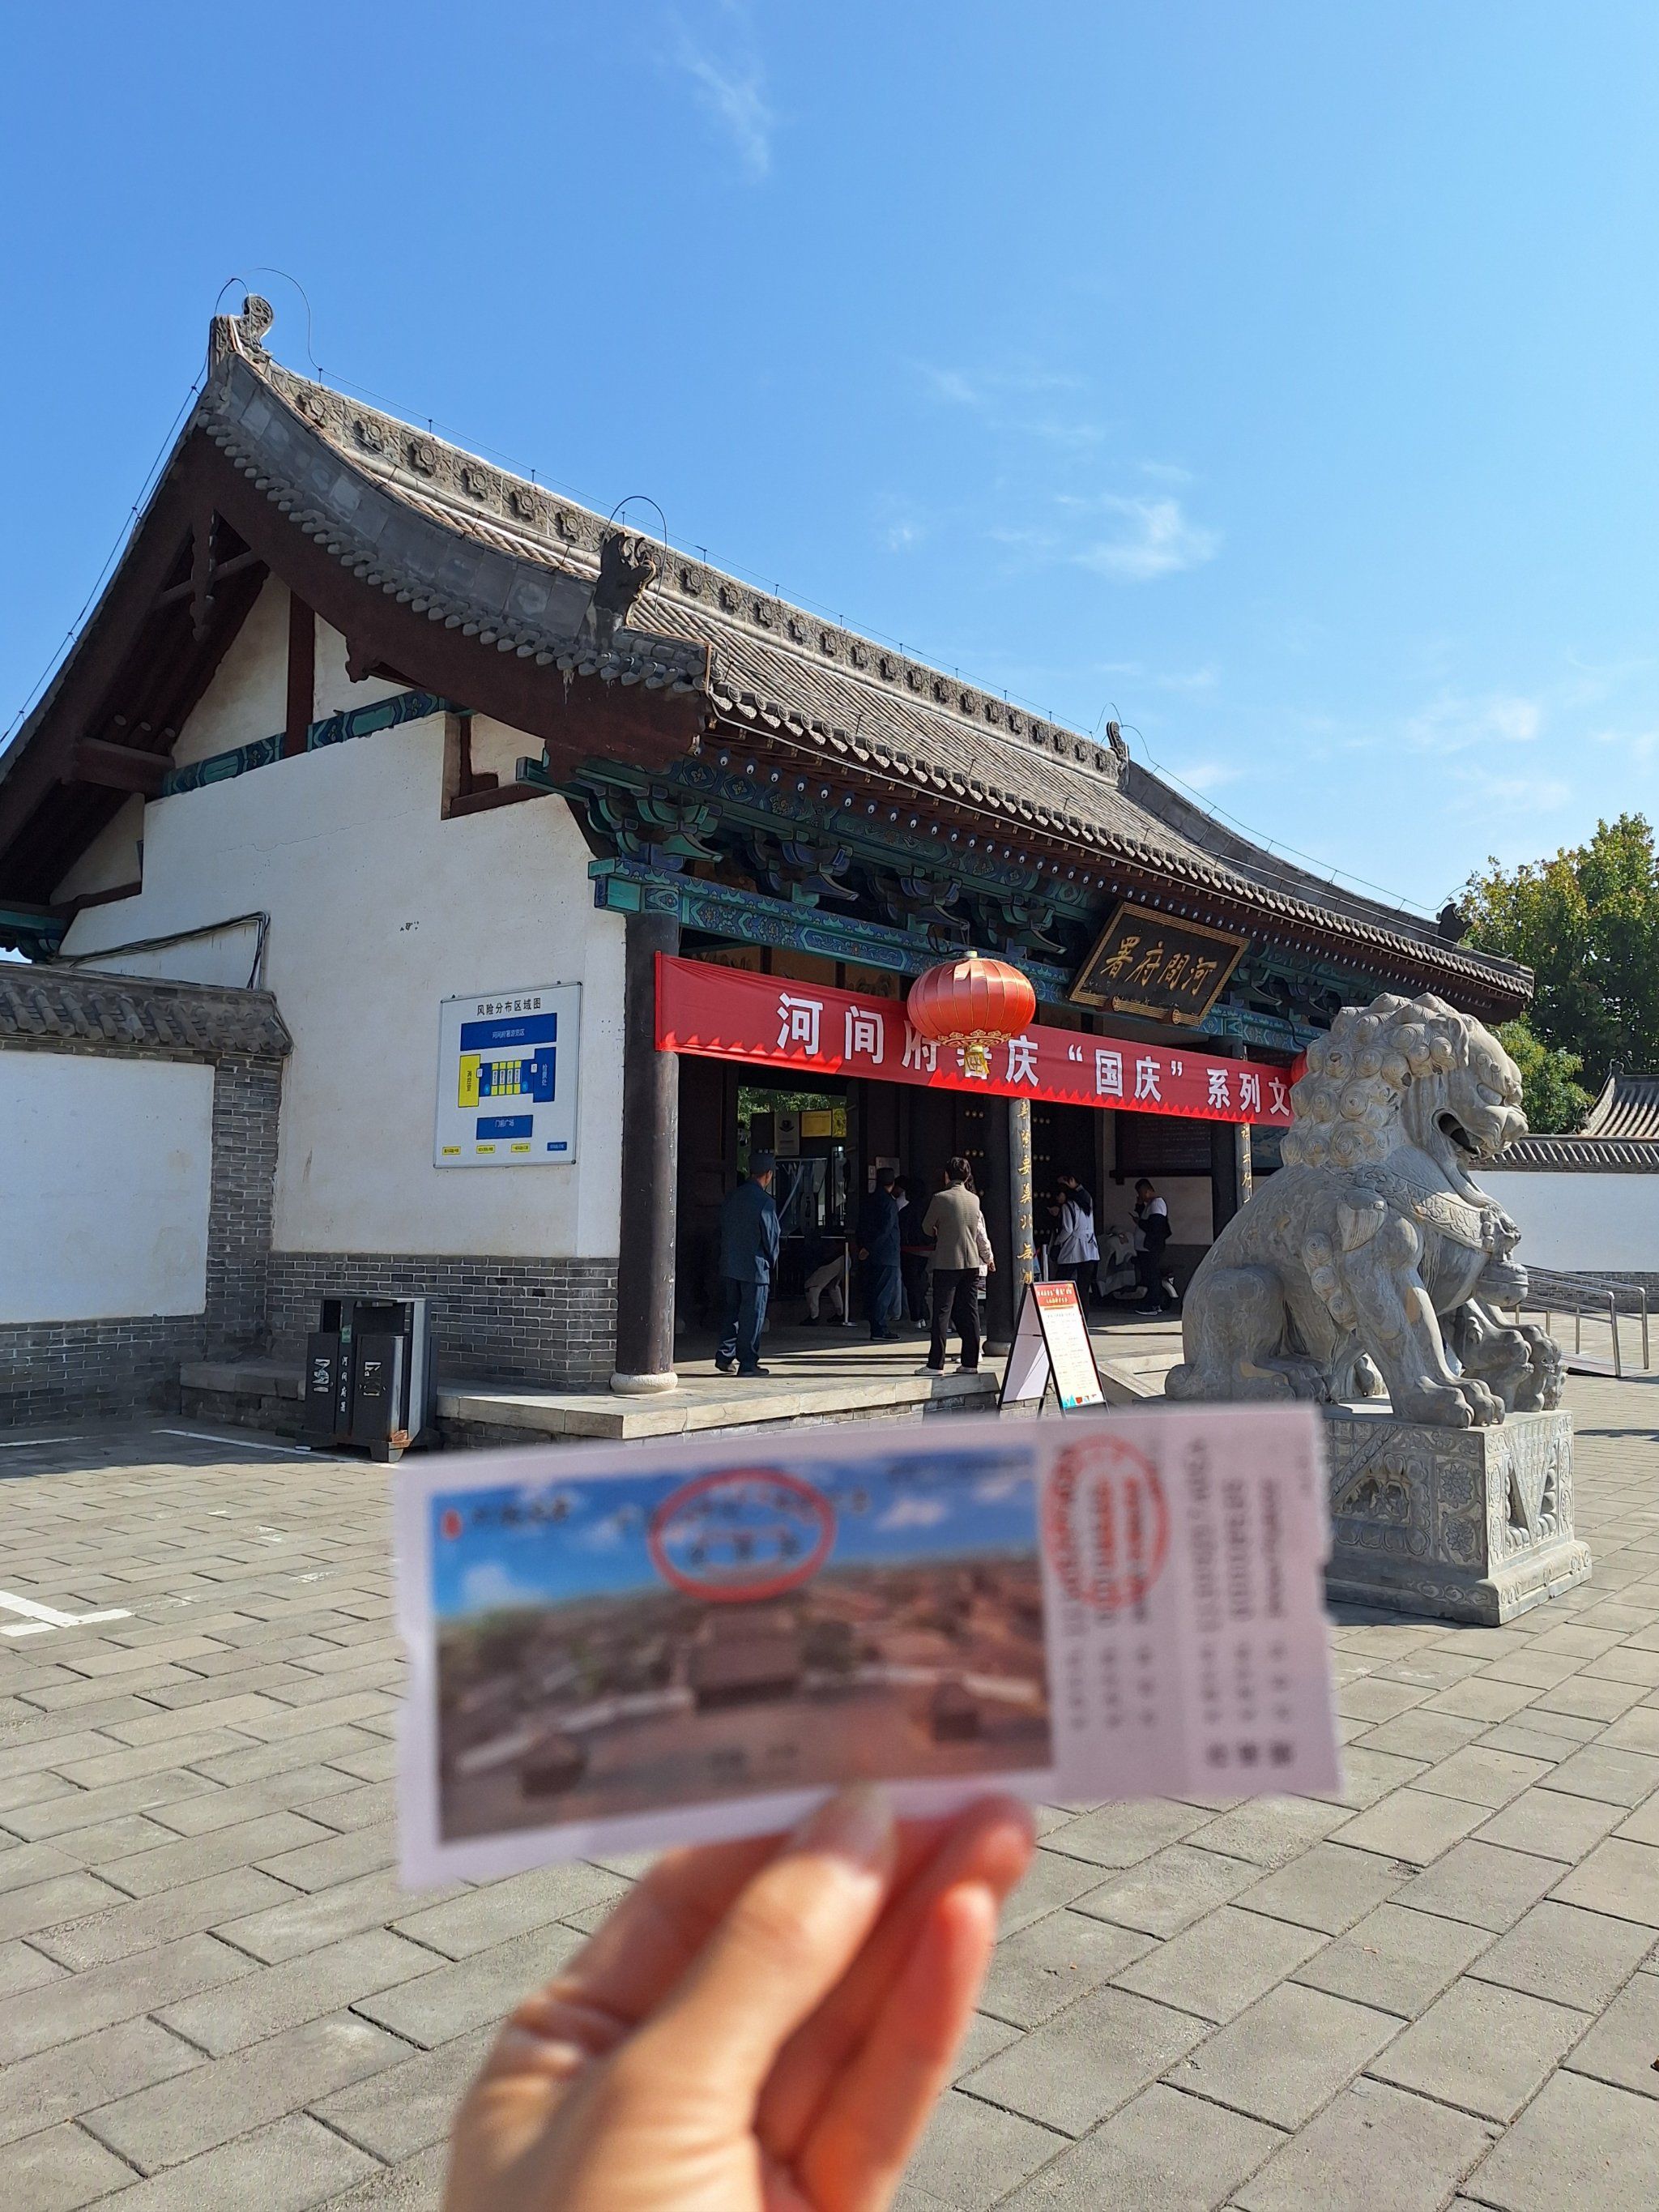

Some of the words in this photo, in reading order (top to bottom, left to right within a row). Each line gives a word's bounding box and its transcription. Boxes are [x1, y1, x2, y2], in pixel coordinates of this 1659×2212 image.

[476, 997, 541, 1016] 风险分布区域图
[776, 992, 1290, 1117] 河间府庆“国庆”系列文
